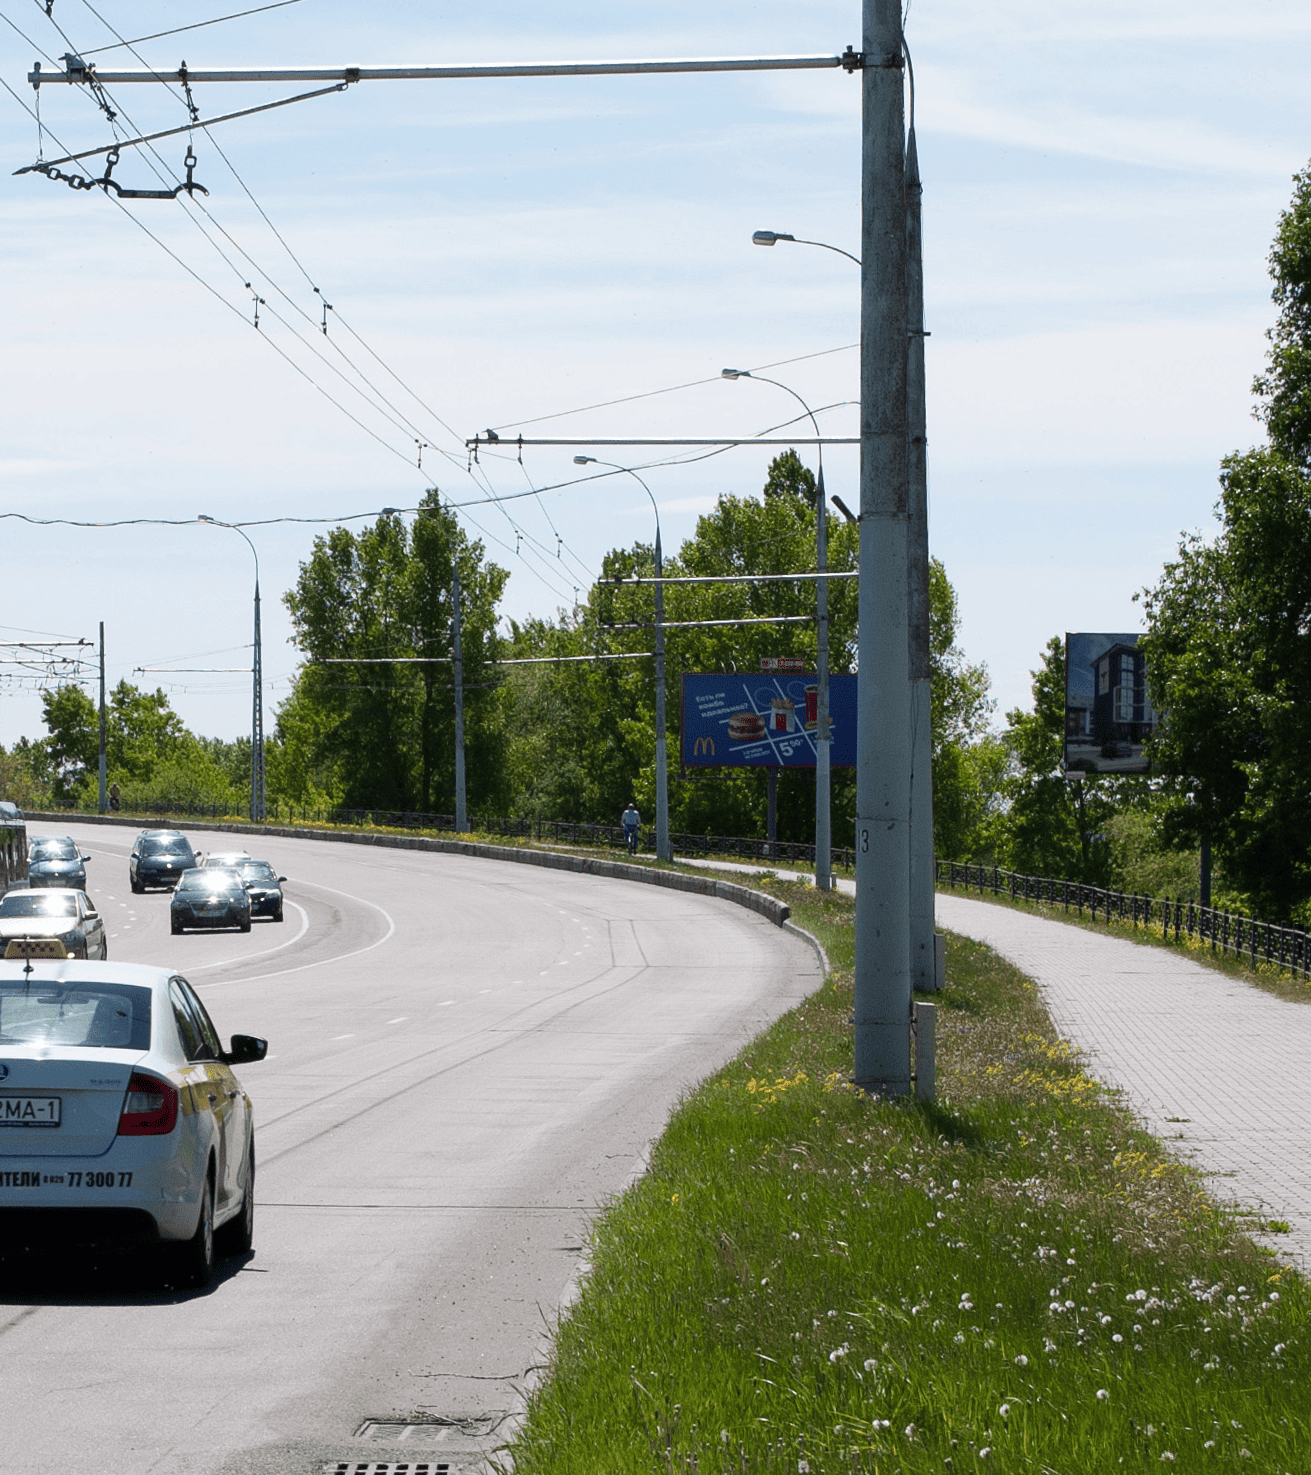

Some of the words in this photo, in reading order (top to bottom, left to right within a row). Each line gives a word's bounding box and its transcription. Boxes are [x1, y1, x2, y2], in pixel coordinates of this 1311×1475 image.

[67, 1171, 83, 1188] 77
[85, 1171, 115, 1188] 300
[118, 1171, 133, 1188] 77
